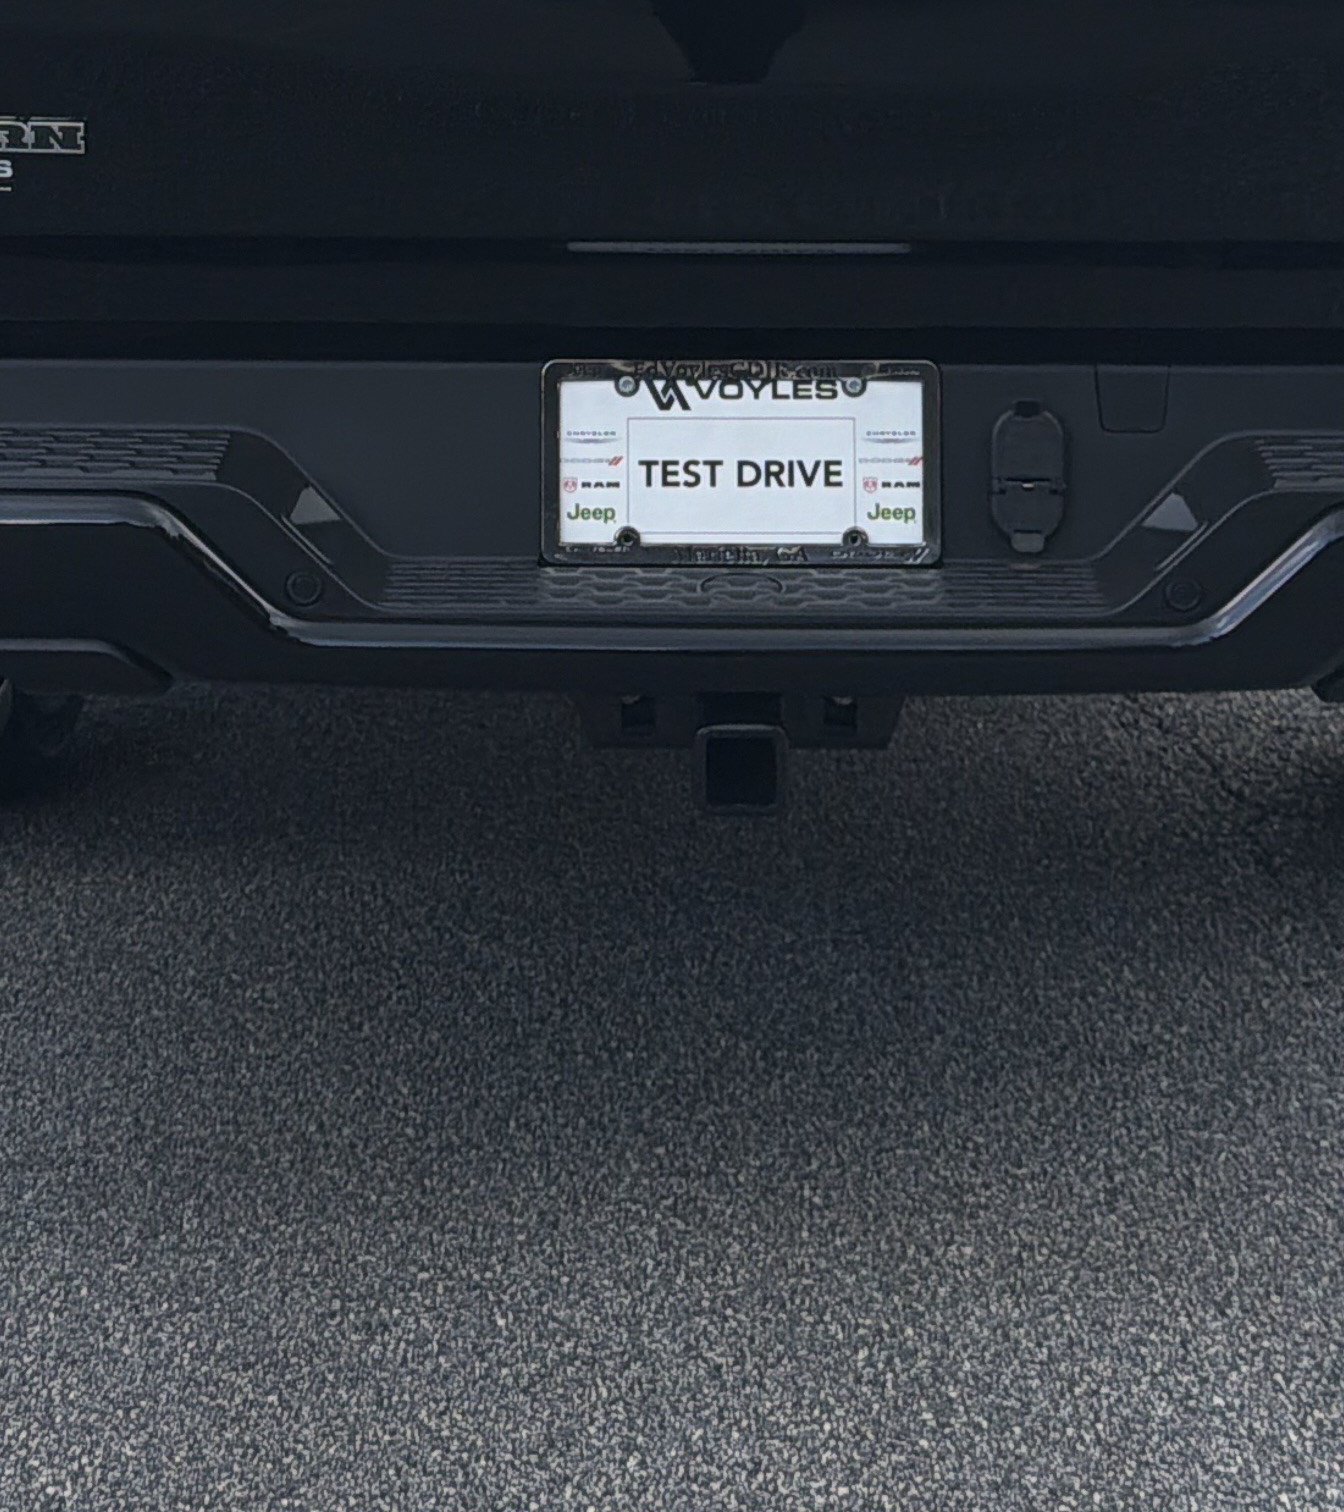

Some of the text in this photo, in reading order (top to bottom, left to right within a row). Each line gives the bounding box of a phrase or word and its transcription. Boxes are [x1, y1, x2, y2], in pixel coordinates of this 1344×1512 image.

[691, 378, 838, 400] VOYLES
[638, 459, 844, 488] TEST DRIVE
[567, 502, 616, 524] Jeep
[867, 502, 916, 524] Jeep
